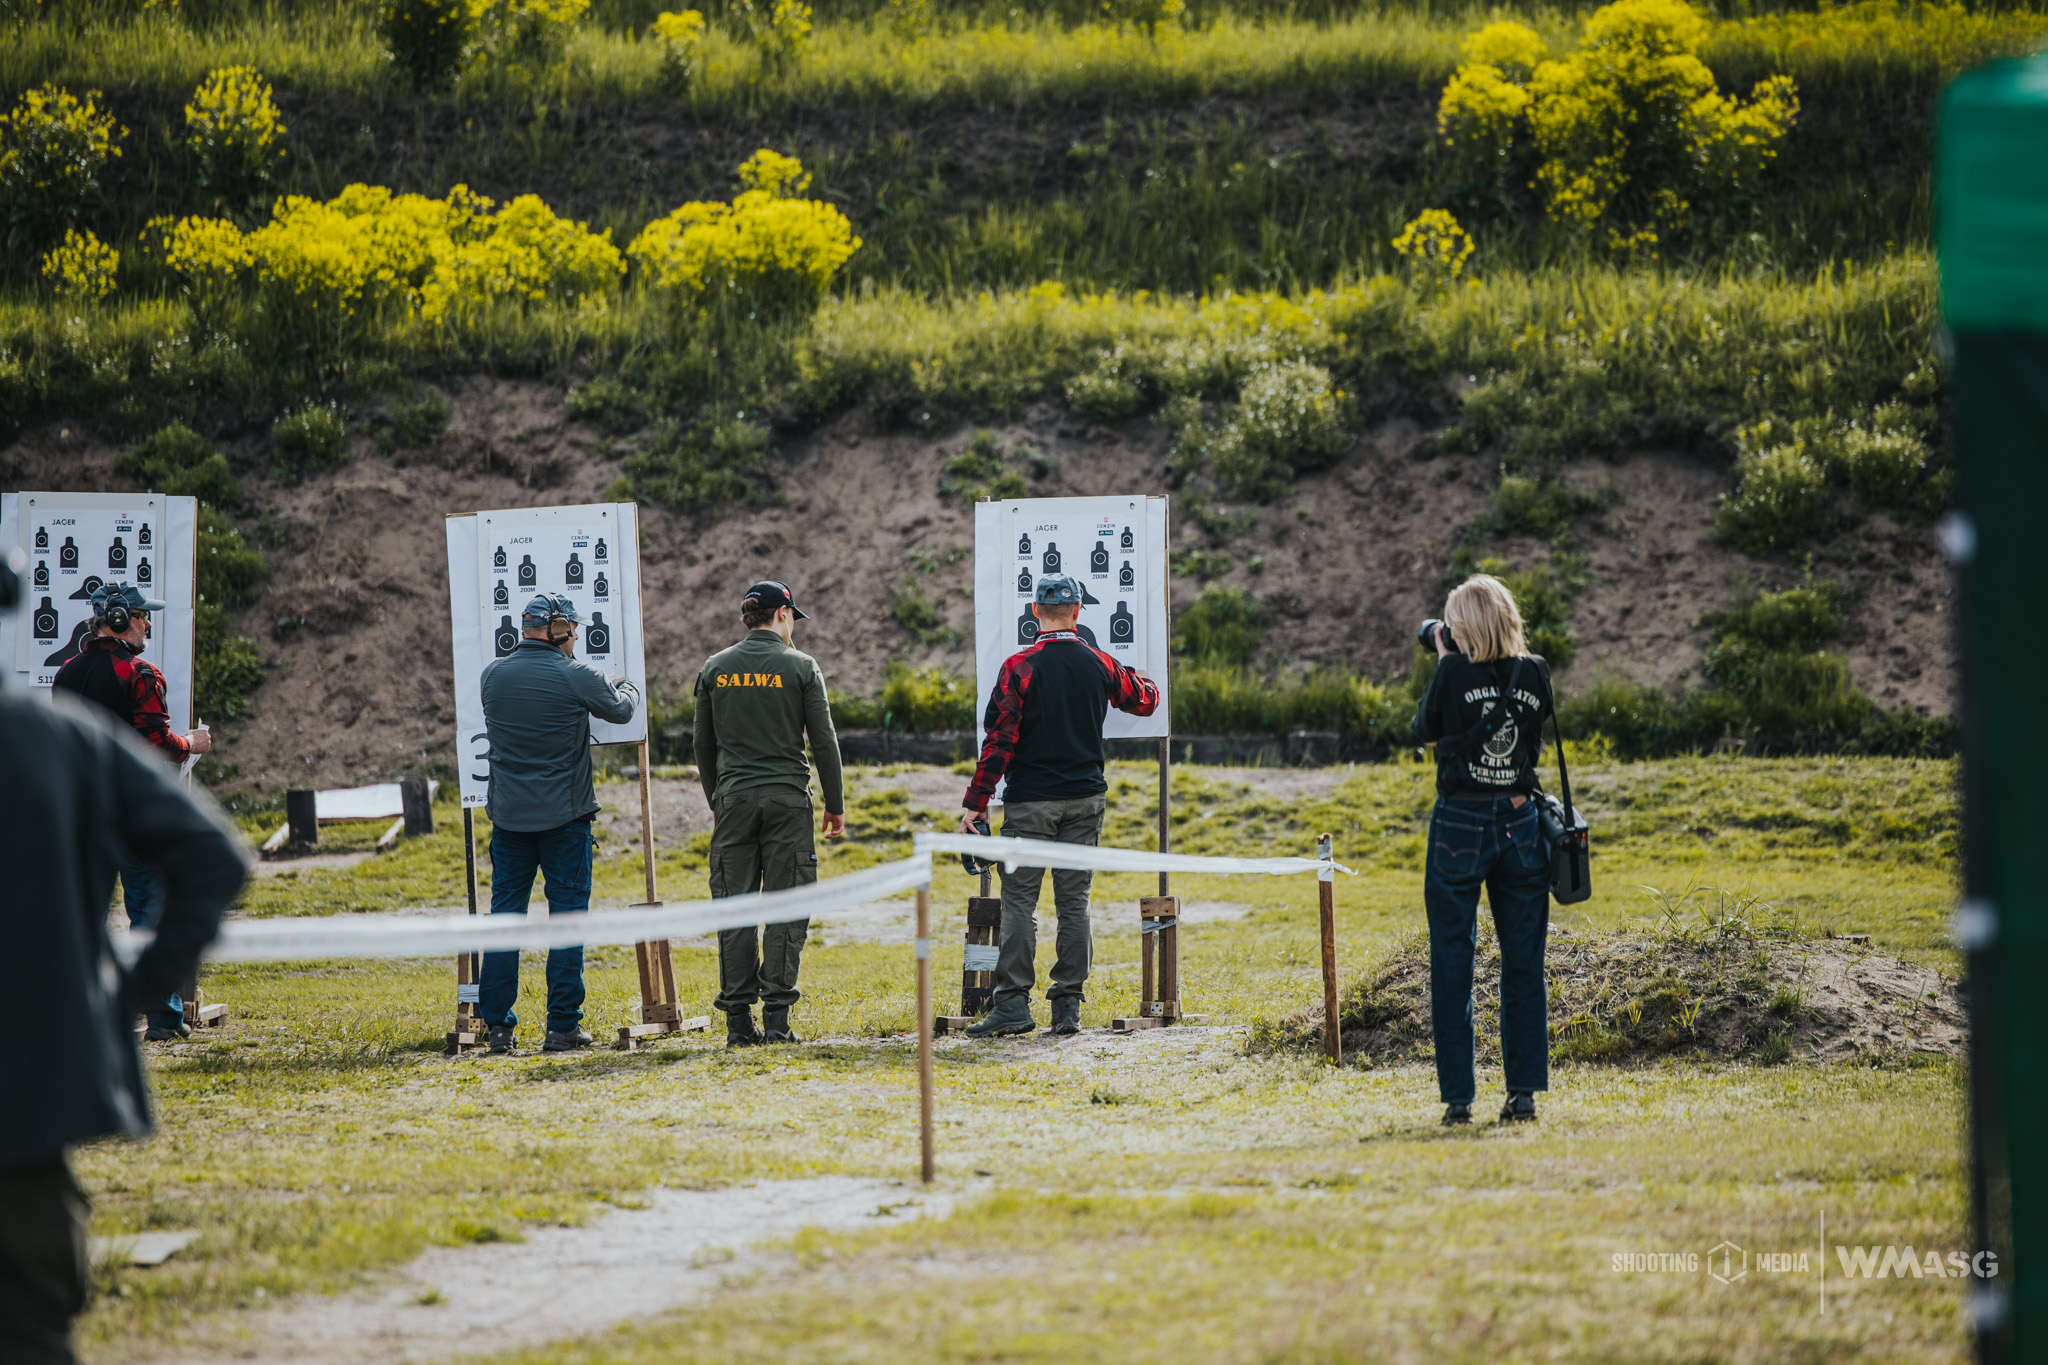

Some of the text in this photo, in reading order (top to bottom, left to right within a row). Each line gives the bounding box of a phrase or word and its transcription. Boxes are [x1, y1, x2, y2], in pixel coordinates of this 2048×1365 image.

[52, 518, 76, 526] JAGER
[1034, 524, 1059, 532] JAGER
[716, 673, 783, 688] SALWA
[1481, 754, 1512, 767] CREW
